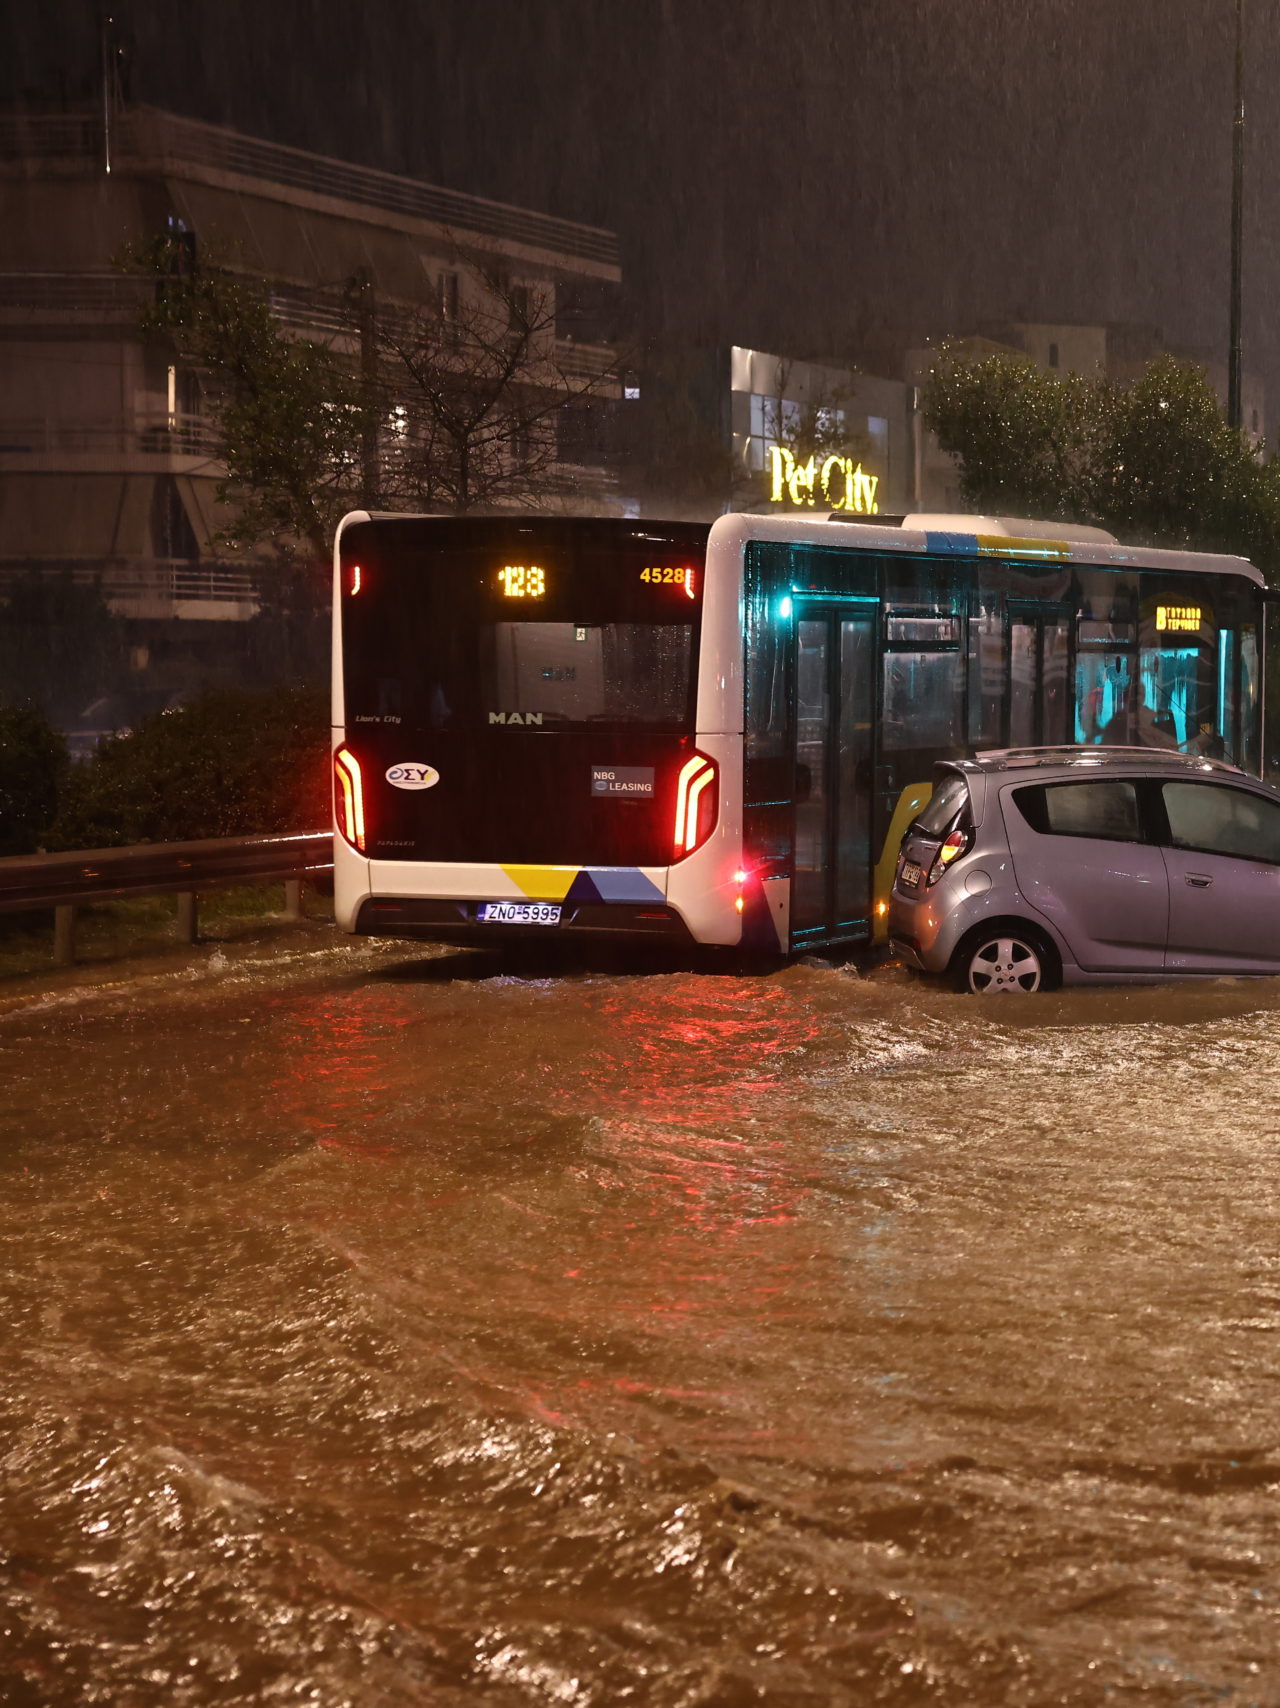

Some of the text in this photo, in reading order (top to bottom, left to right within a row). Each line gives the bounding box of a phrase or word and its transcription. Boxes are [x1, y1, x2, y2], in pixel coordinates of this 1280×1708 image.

[768, 446, 818, 506] Pet
[498, 566, 546, 597] 123
[639, 567, 685, 584] 4528
[489, 712, 543, 725] MAN
[593, 771, 616, 780] NBG
[609, 782, 652, 792] LEASING
